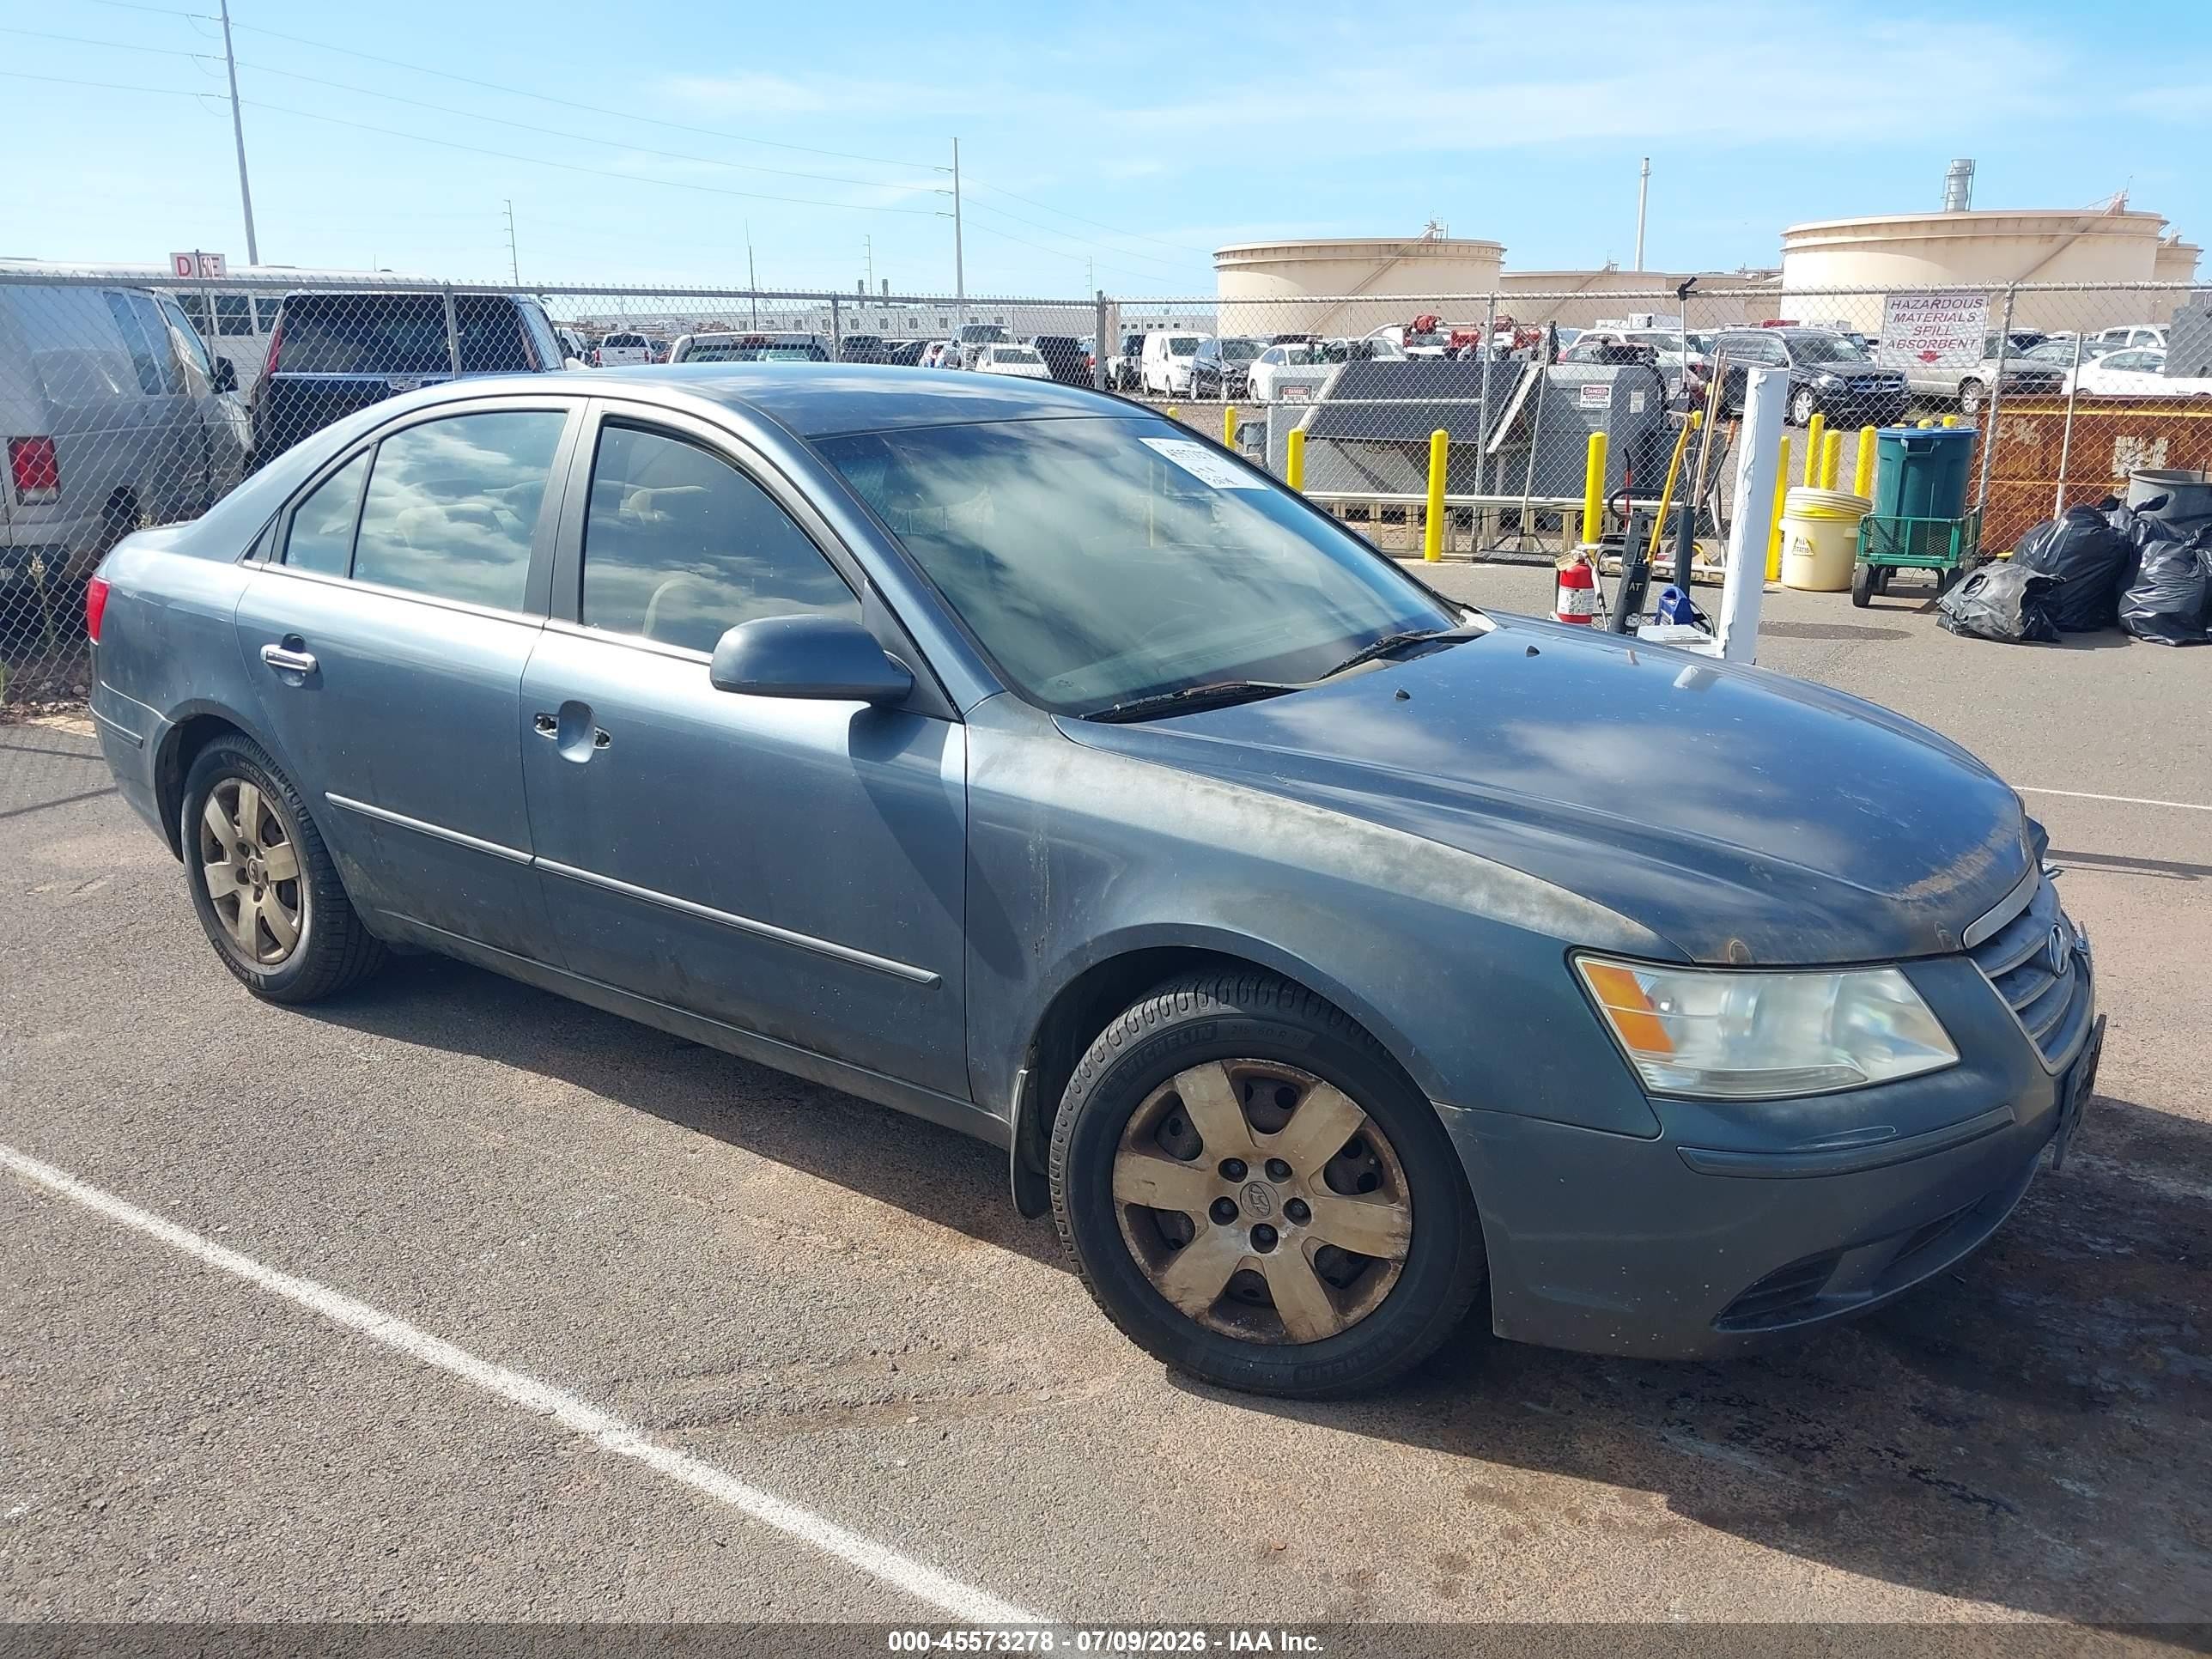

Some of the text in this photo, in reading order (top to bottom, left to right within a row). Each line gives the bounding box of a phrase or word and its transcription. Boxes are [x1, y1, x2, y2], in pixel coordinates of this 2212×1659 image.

[177, 257, 191, 276] D
[1890, 298, 1984, 309] HAZARDOUS
[1893, 312, 1976, 323] MATERIALS
[1913, 325, 1952, 336] SPILL
[1886, 338, 1978, 349] ABSORBENT
[1121, 1024, 1216, 1079] MICHELIN
